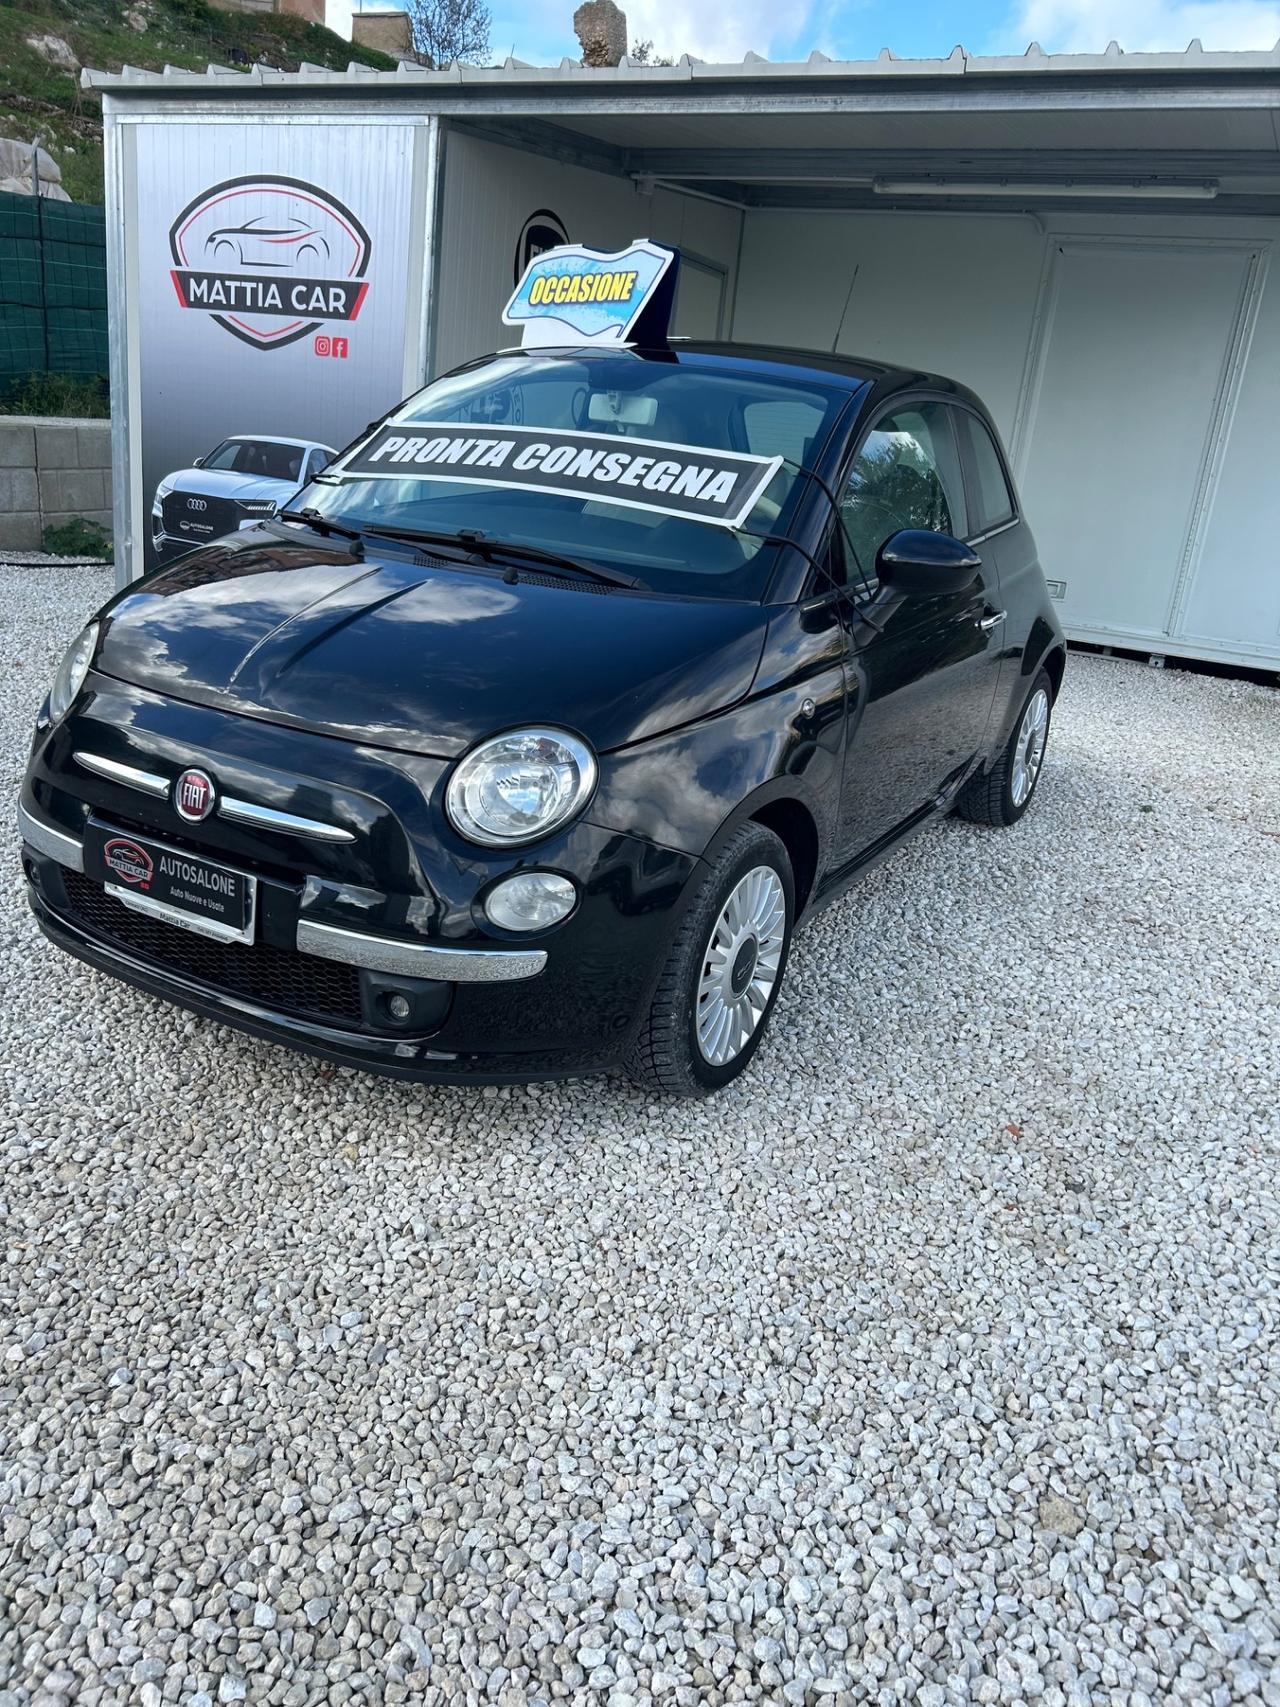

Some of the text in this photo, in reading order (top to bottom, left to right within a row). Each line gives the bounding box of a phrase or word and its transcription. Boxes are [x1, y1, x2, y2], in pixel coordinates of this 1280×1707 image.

[189, 278, 346, 313] MATTIA CAR
[529, 271, 638, 306] OCCASIONE
[368, 435, 738, 504] PRONTA CONSEGNA
[183, 783, 207, 809] FIAT
[109, 858, 148, 878] MATTIA CAR
[160, 856, 235, 897] AUTOSALONE
[170, 886, 225, 913] Auto Nuove e Usate
[160, 912, 191, 929] Mattia Car
